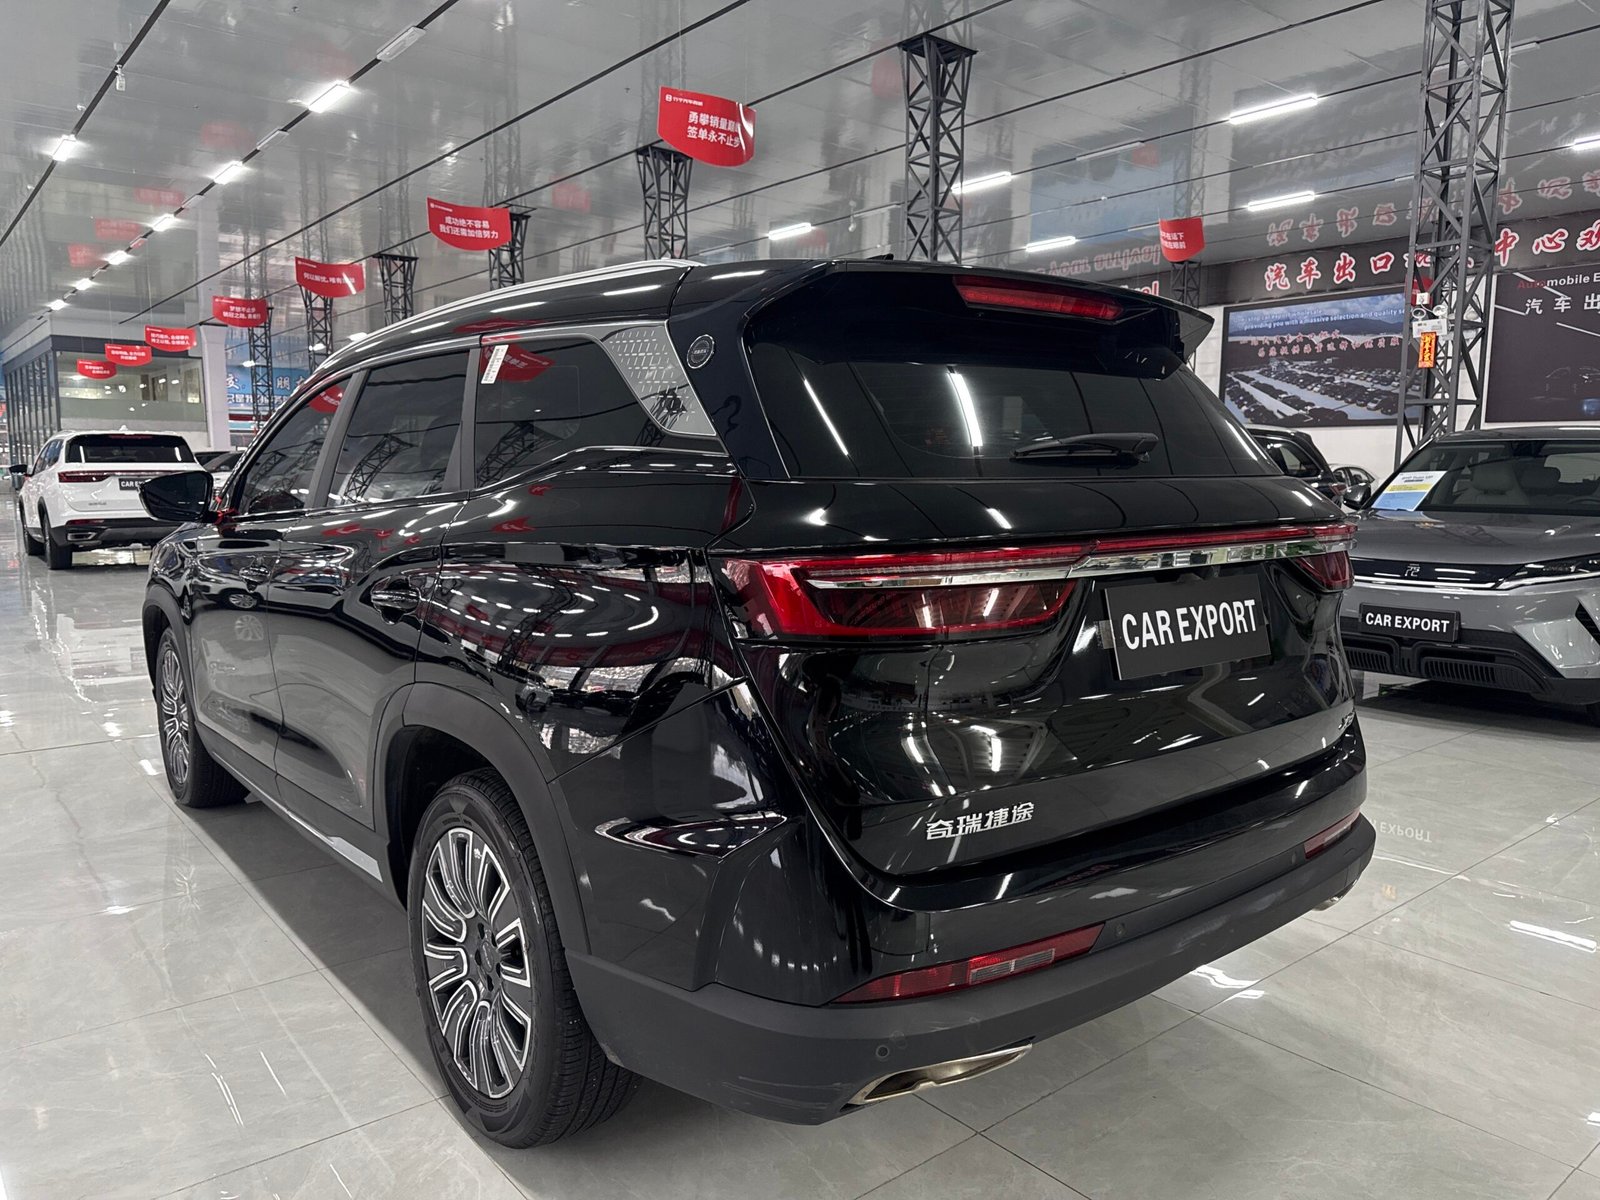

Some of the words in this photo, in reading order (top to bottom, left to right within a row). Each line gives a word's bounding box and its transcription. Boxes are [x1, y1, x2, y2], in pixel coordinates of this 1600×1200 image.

[687, 125, 741, 148] 签单永不止步
[121, 480, 135, 488] CAR
[1121, 609, 1174, 652] CAR
[1176, 599, 1258, 643] EXPORT
[1365, 612, 1392, 627] CAR
[1394, 616, 1450, 633] EXPORT
[926, 801, 1035, 841] 奇瑞捷途
